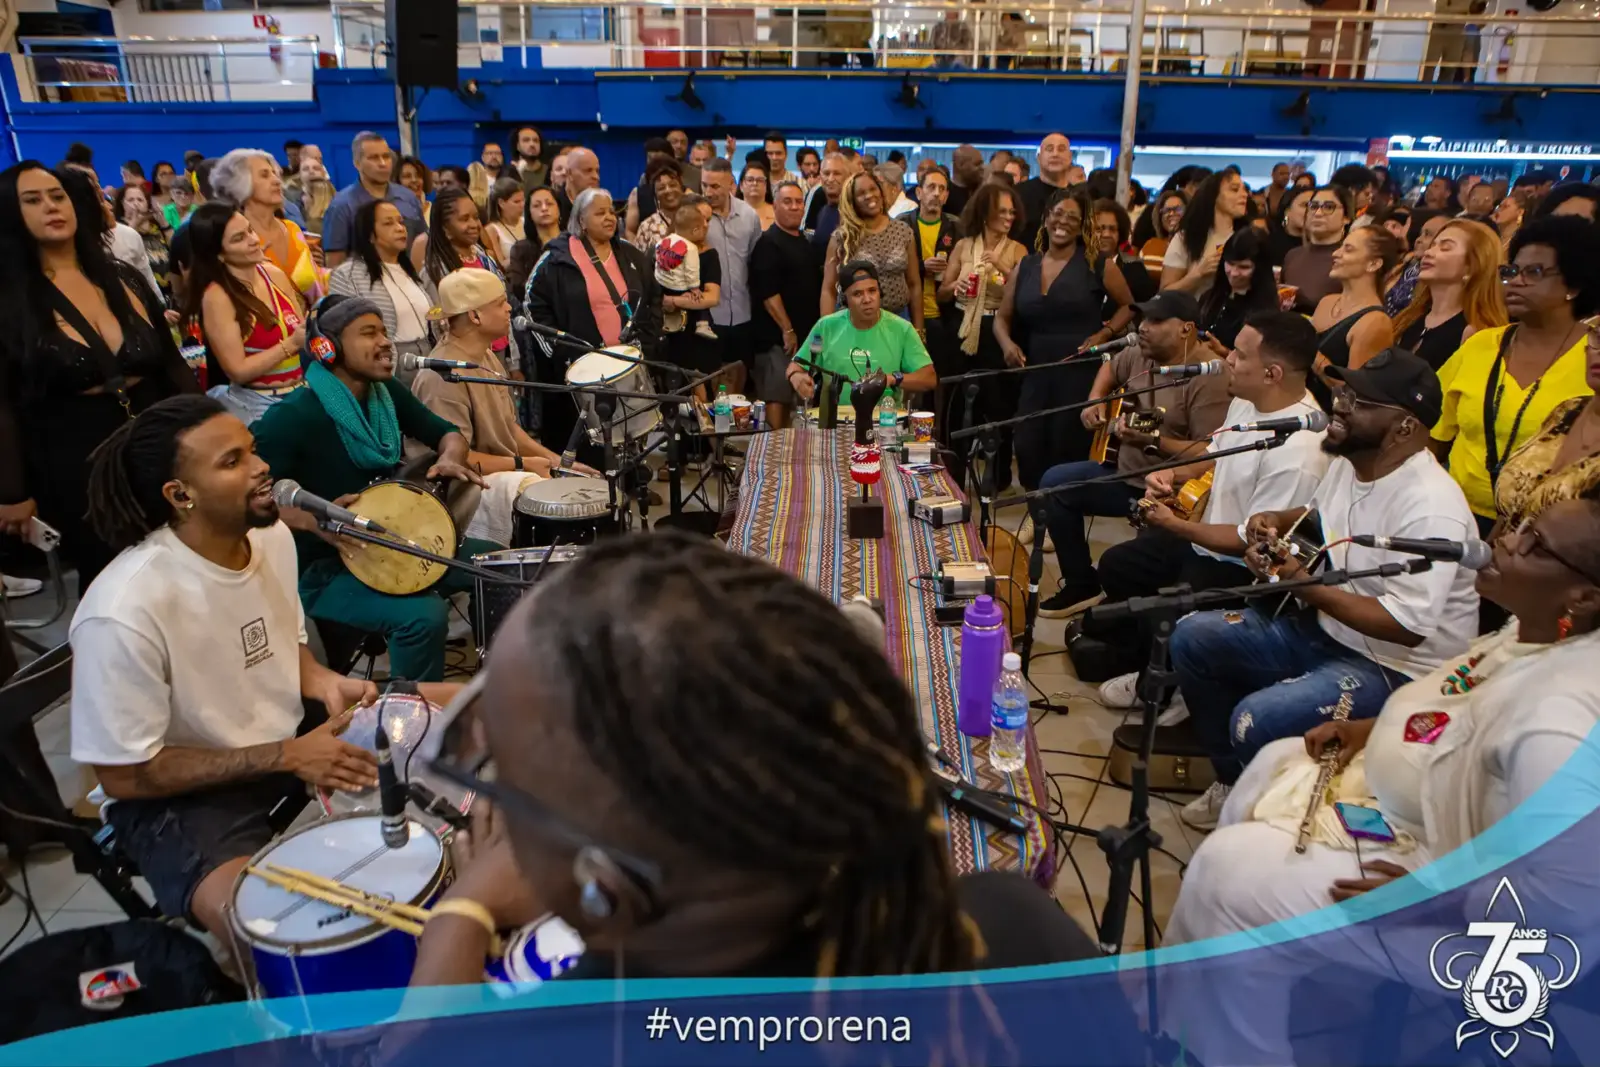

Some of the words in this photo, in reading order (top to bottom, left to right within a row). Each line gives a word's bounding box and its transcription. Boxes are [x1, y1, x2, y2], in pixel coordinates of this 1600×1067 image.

[1428, 141, 1520, 154] CAIPIRINHAS
[1523, 143, 1534, 154] E
[1538, 144, 1593, 155] DRINKS
